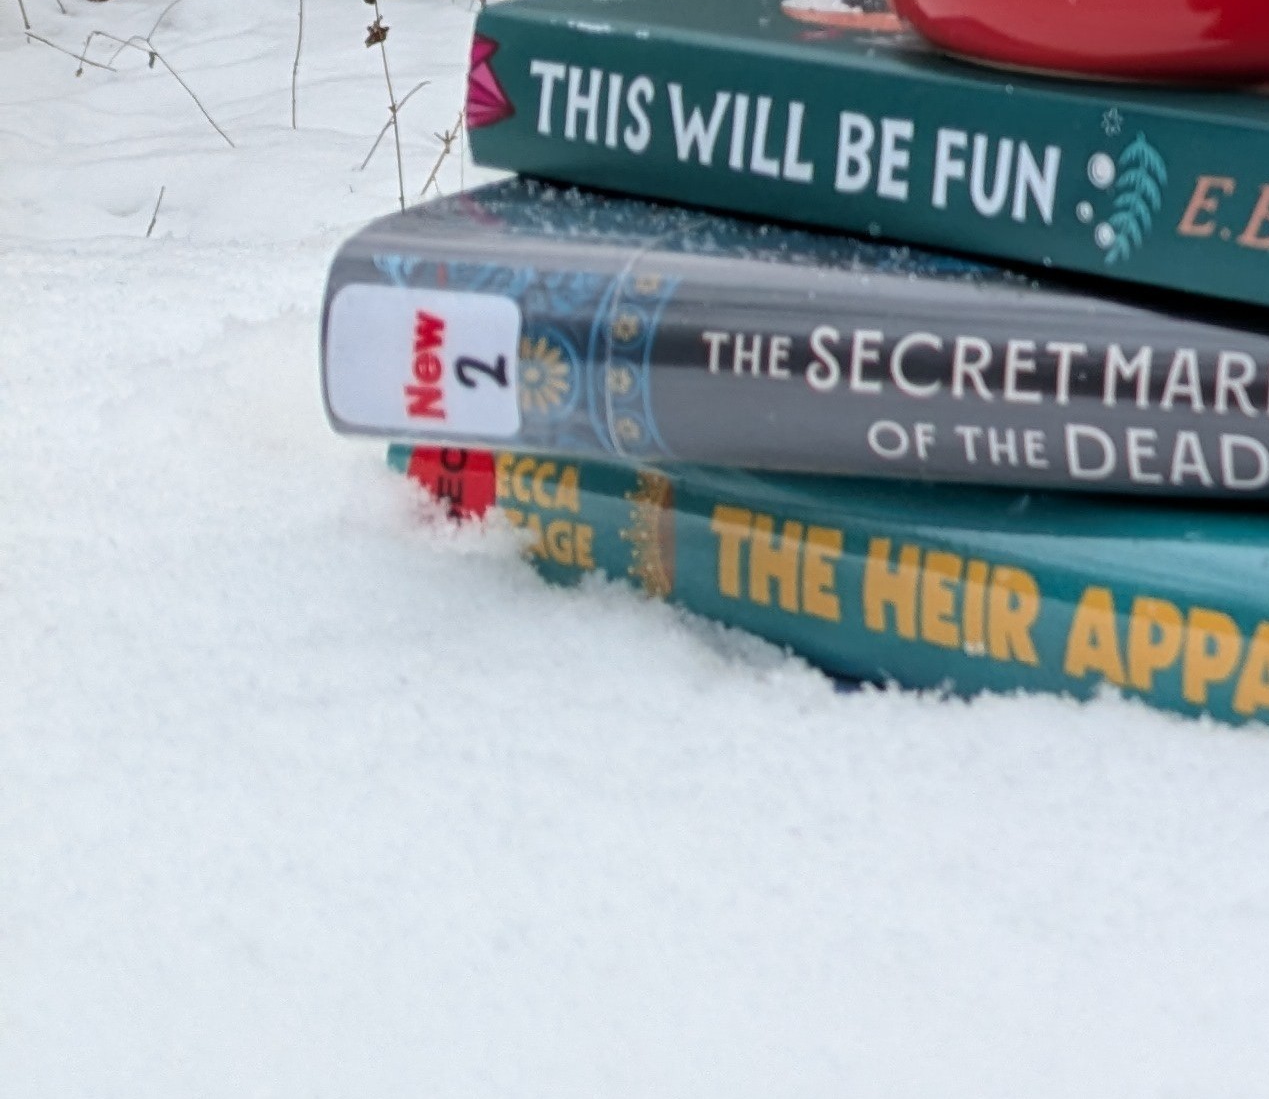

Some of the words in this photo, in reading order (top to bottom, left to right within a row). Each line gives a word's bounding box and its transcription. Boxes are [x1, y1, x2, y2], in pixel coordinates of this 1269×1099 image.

[530, 59, 655, 154] THIS
[667, 83, 814, 183] WILL
[834, 111, 914, 200] BE
[932, 128, 1061, 224] FUN
[404, 309, 446, 420] New
[454, 353, 509, 389] 2
[702, 331, 792, 380] THE
[805, 325, 1087, 405] SECRET
[868, 419, 935, 460] OF
[955, 424, 1050, 469] THE
[710, 505, 842, 623] THE
[863, 536, 1041, 666] HEIR
